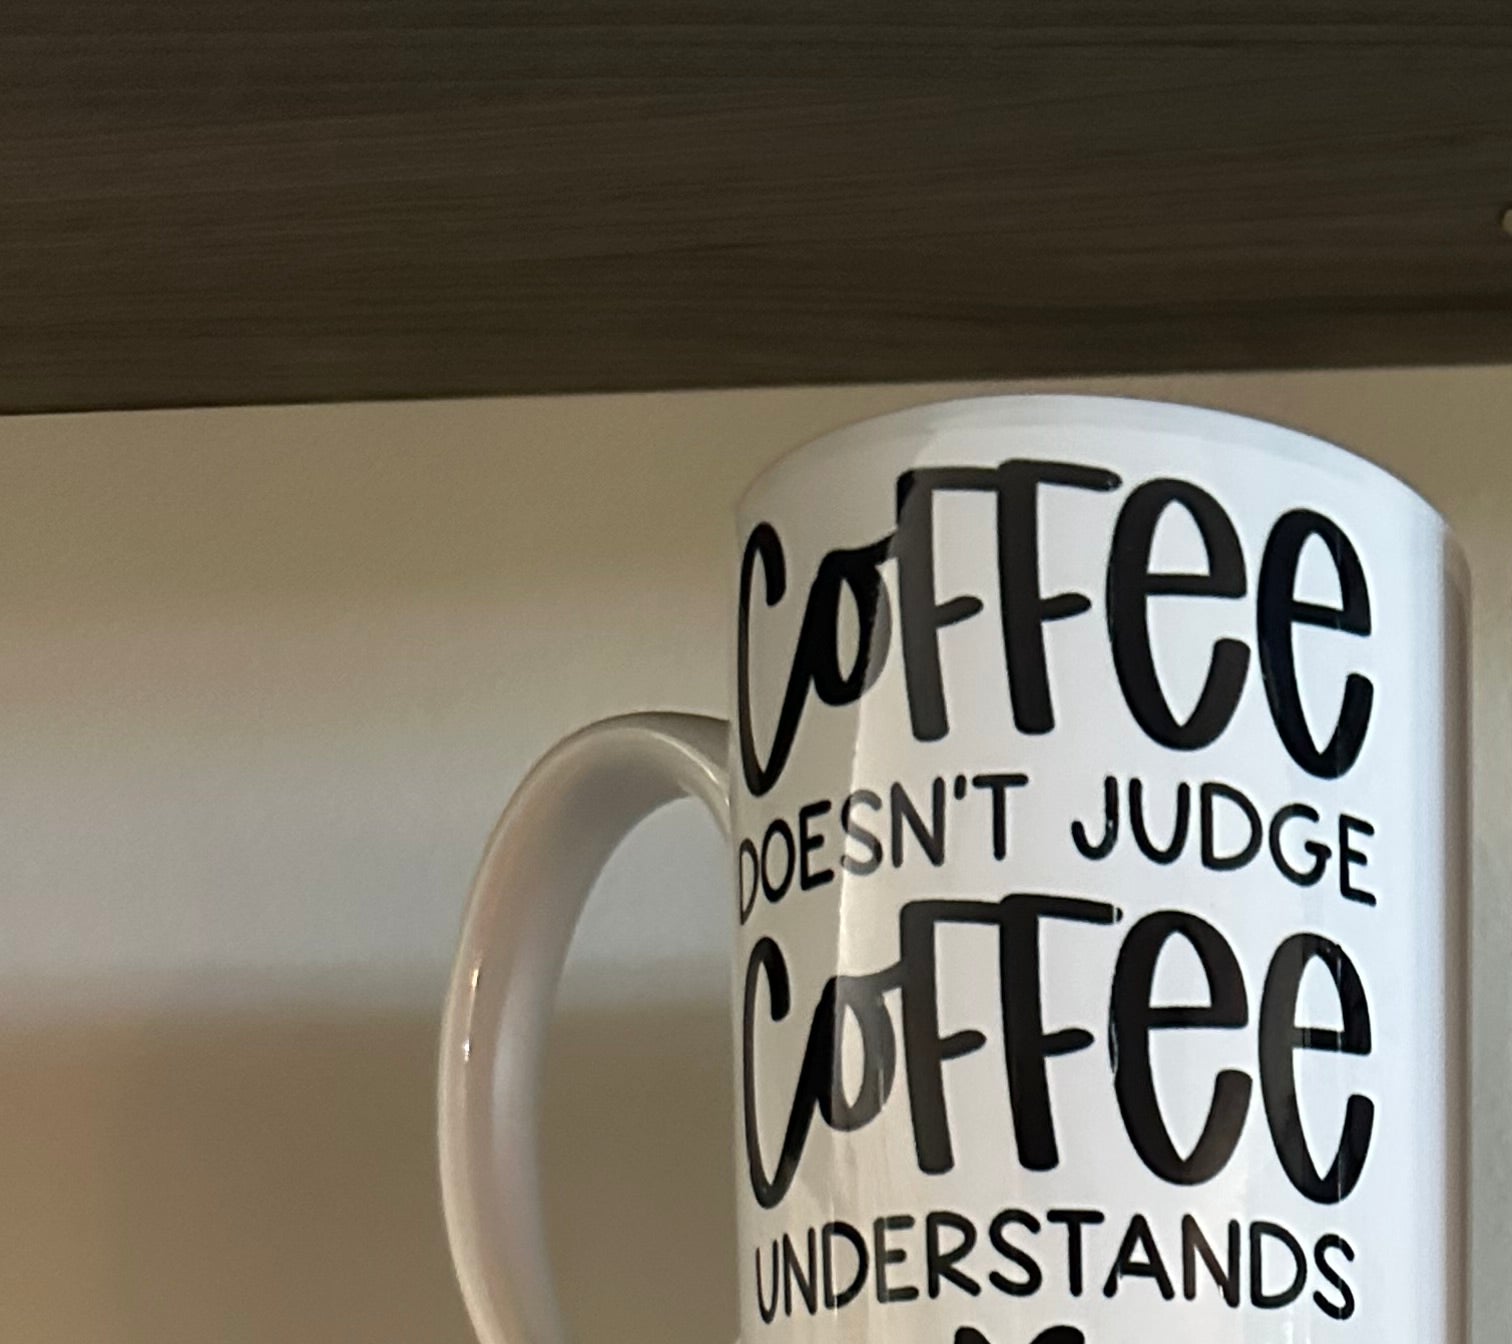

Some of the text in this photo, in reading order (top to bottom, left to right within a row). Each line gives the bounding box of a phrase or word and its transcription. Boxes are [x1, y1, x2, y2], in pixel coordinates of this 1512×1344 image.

[739, 773, 1377, 925] DOESN'T JUDGE
[755, 1208, 1357, 1324] UNDERSTANDS
